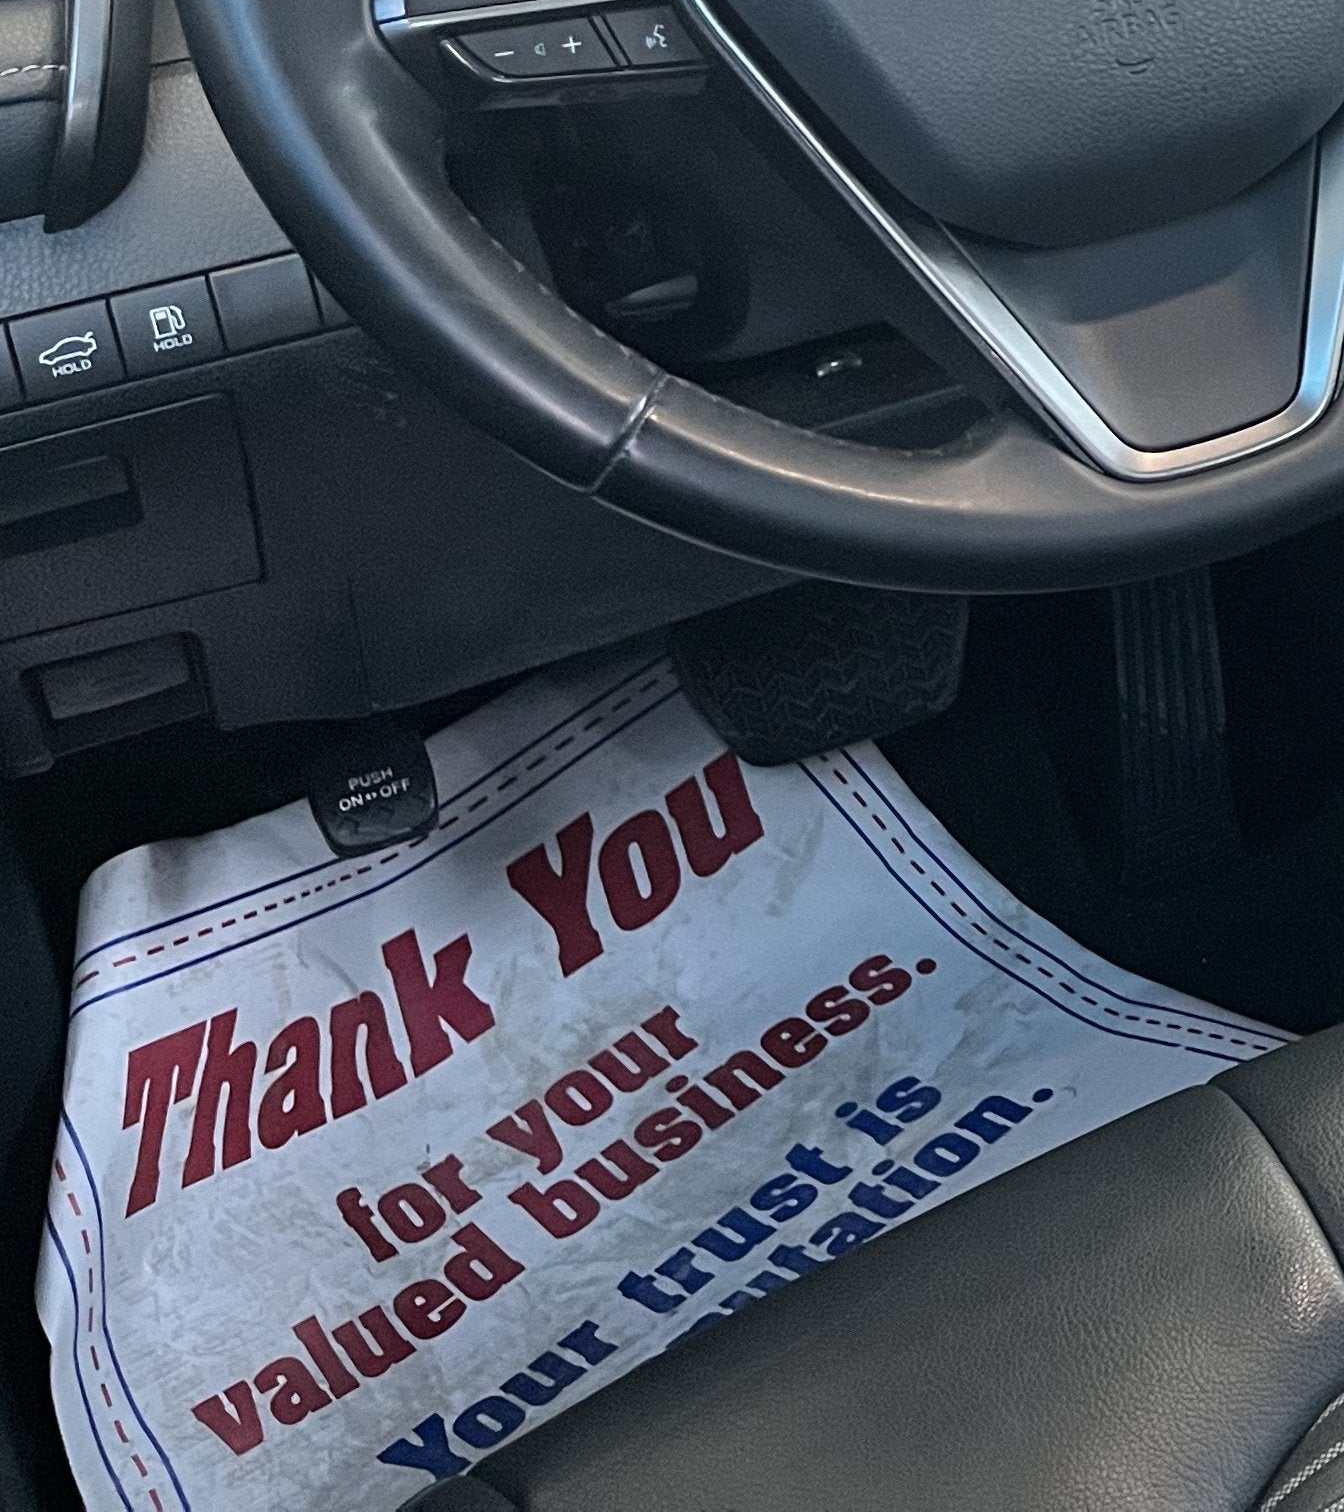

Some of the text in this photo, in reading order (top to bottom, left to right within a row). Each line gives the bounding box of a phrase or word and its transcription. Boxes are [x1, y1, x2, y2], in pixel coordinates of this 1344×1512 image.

[52, 359, 92, 378] HOLD
[153, 334, 193, 352] HOLD
[348, 767, 393, 790] PUSH
[119, 750, 765, 1219] Thank You
[190, 951, 938, 1457] valued business.
[335, 1002, 700, 1262] for your
[376, 1076, 942, 1483] Your trust is
